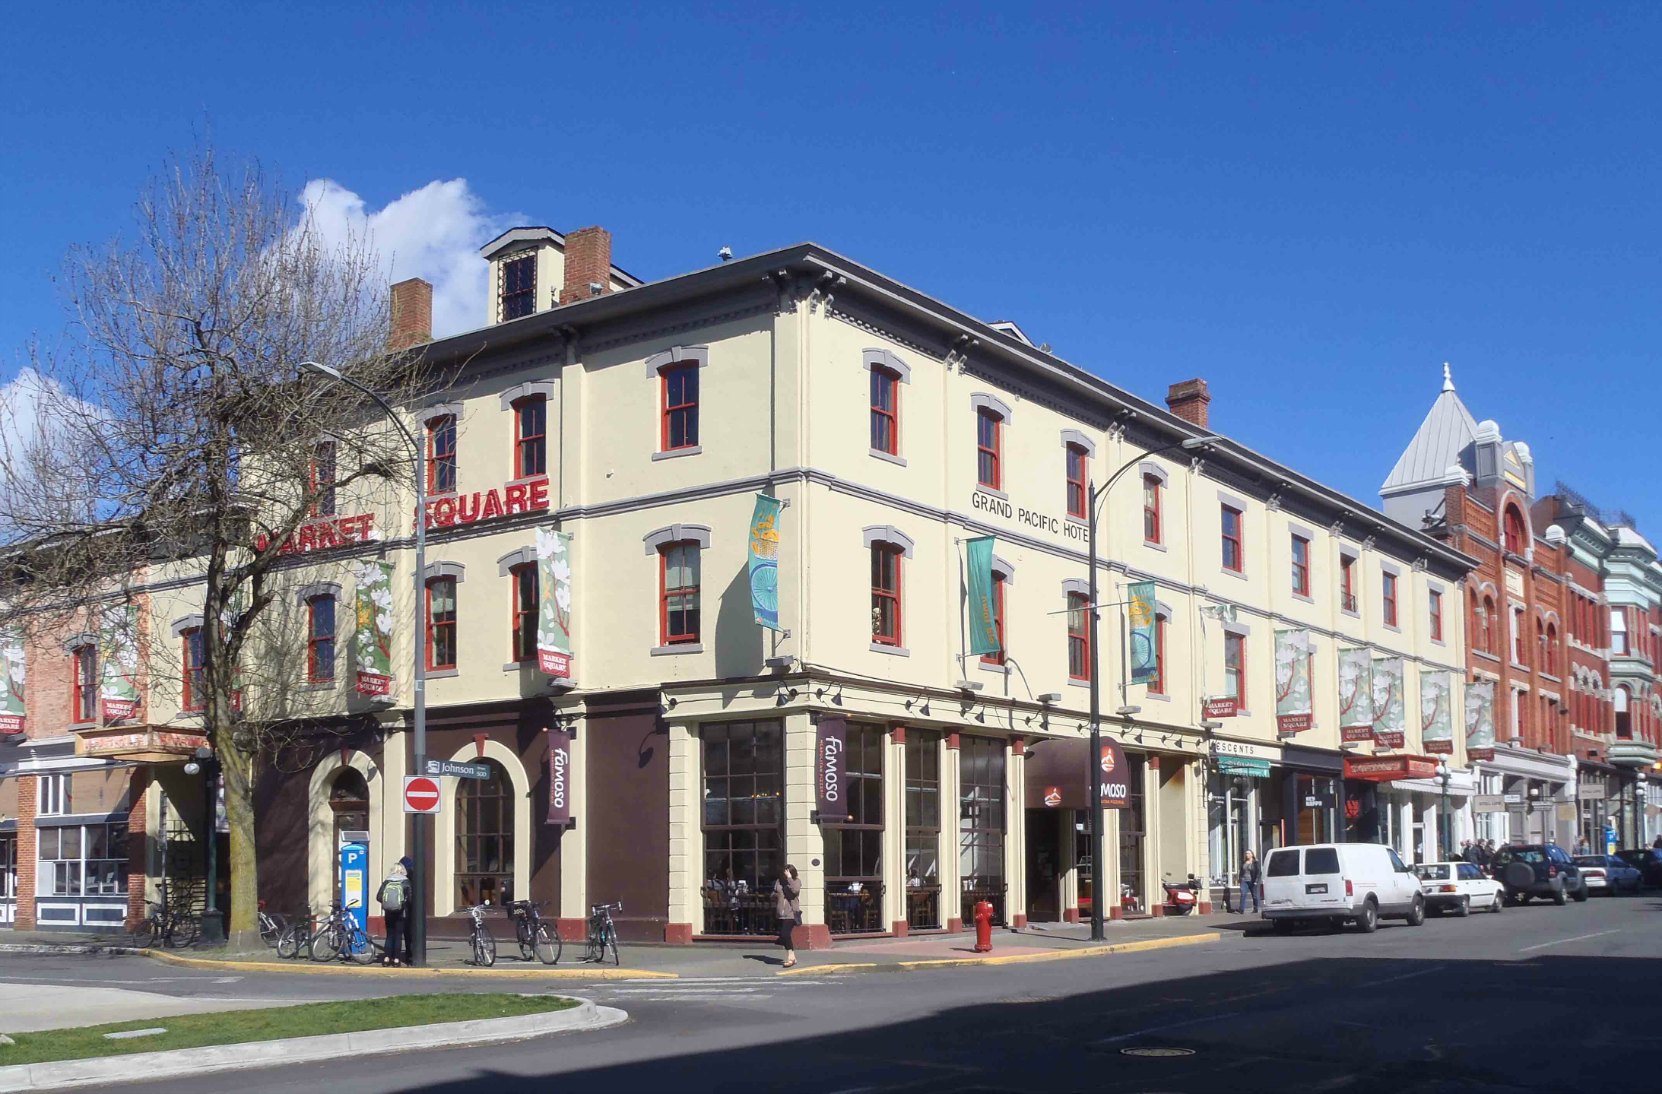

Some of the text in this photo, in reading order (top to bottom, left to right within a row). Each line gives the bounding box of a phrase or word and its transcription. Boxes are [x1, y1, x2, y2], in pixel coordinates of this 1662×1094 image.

[412, 477, 550, 529] SQUARE
[972, 492, 1089, 543] GRAND PACIFIC HOTE
[543, 653, 567, 664] MARKET
[543, 660, 567, 672] SQUARE
[361, 675, 386, 685] MARKET
[0, 723, 20, 731] QUARE
[1282, 721, 1308, 729] SQUARE
[1216, 741, 1254, 755] ESCENTS
[442, 763, 474, 774] Johnson
[348, 853, 358, 864] P
